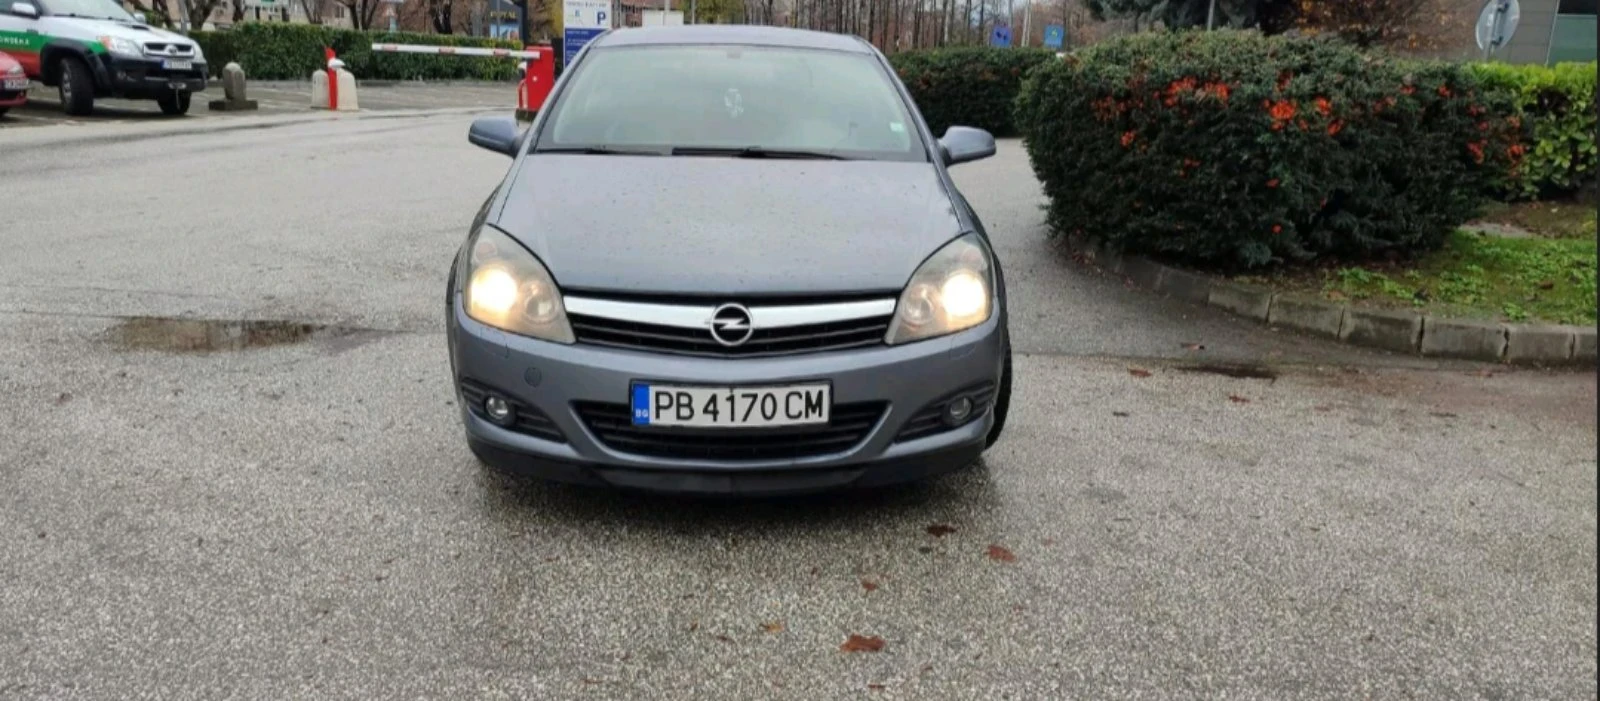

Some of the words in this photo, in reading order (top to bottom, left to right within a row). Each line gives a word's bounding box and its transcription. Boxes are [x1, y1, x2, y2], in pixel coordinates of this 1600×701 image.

[597, 11, 606, 25] P
[635, 409, 649, 418] BG
[655, 391, 695, 421] PB
[702, 392, 778, 423] 4170
[785, 390, 824, 420] CM
